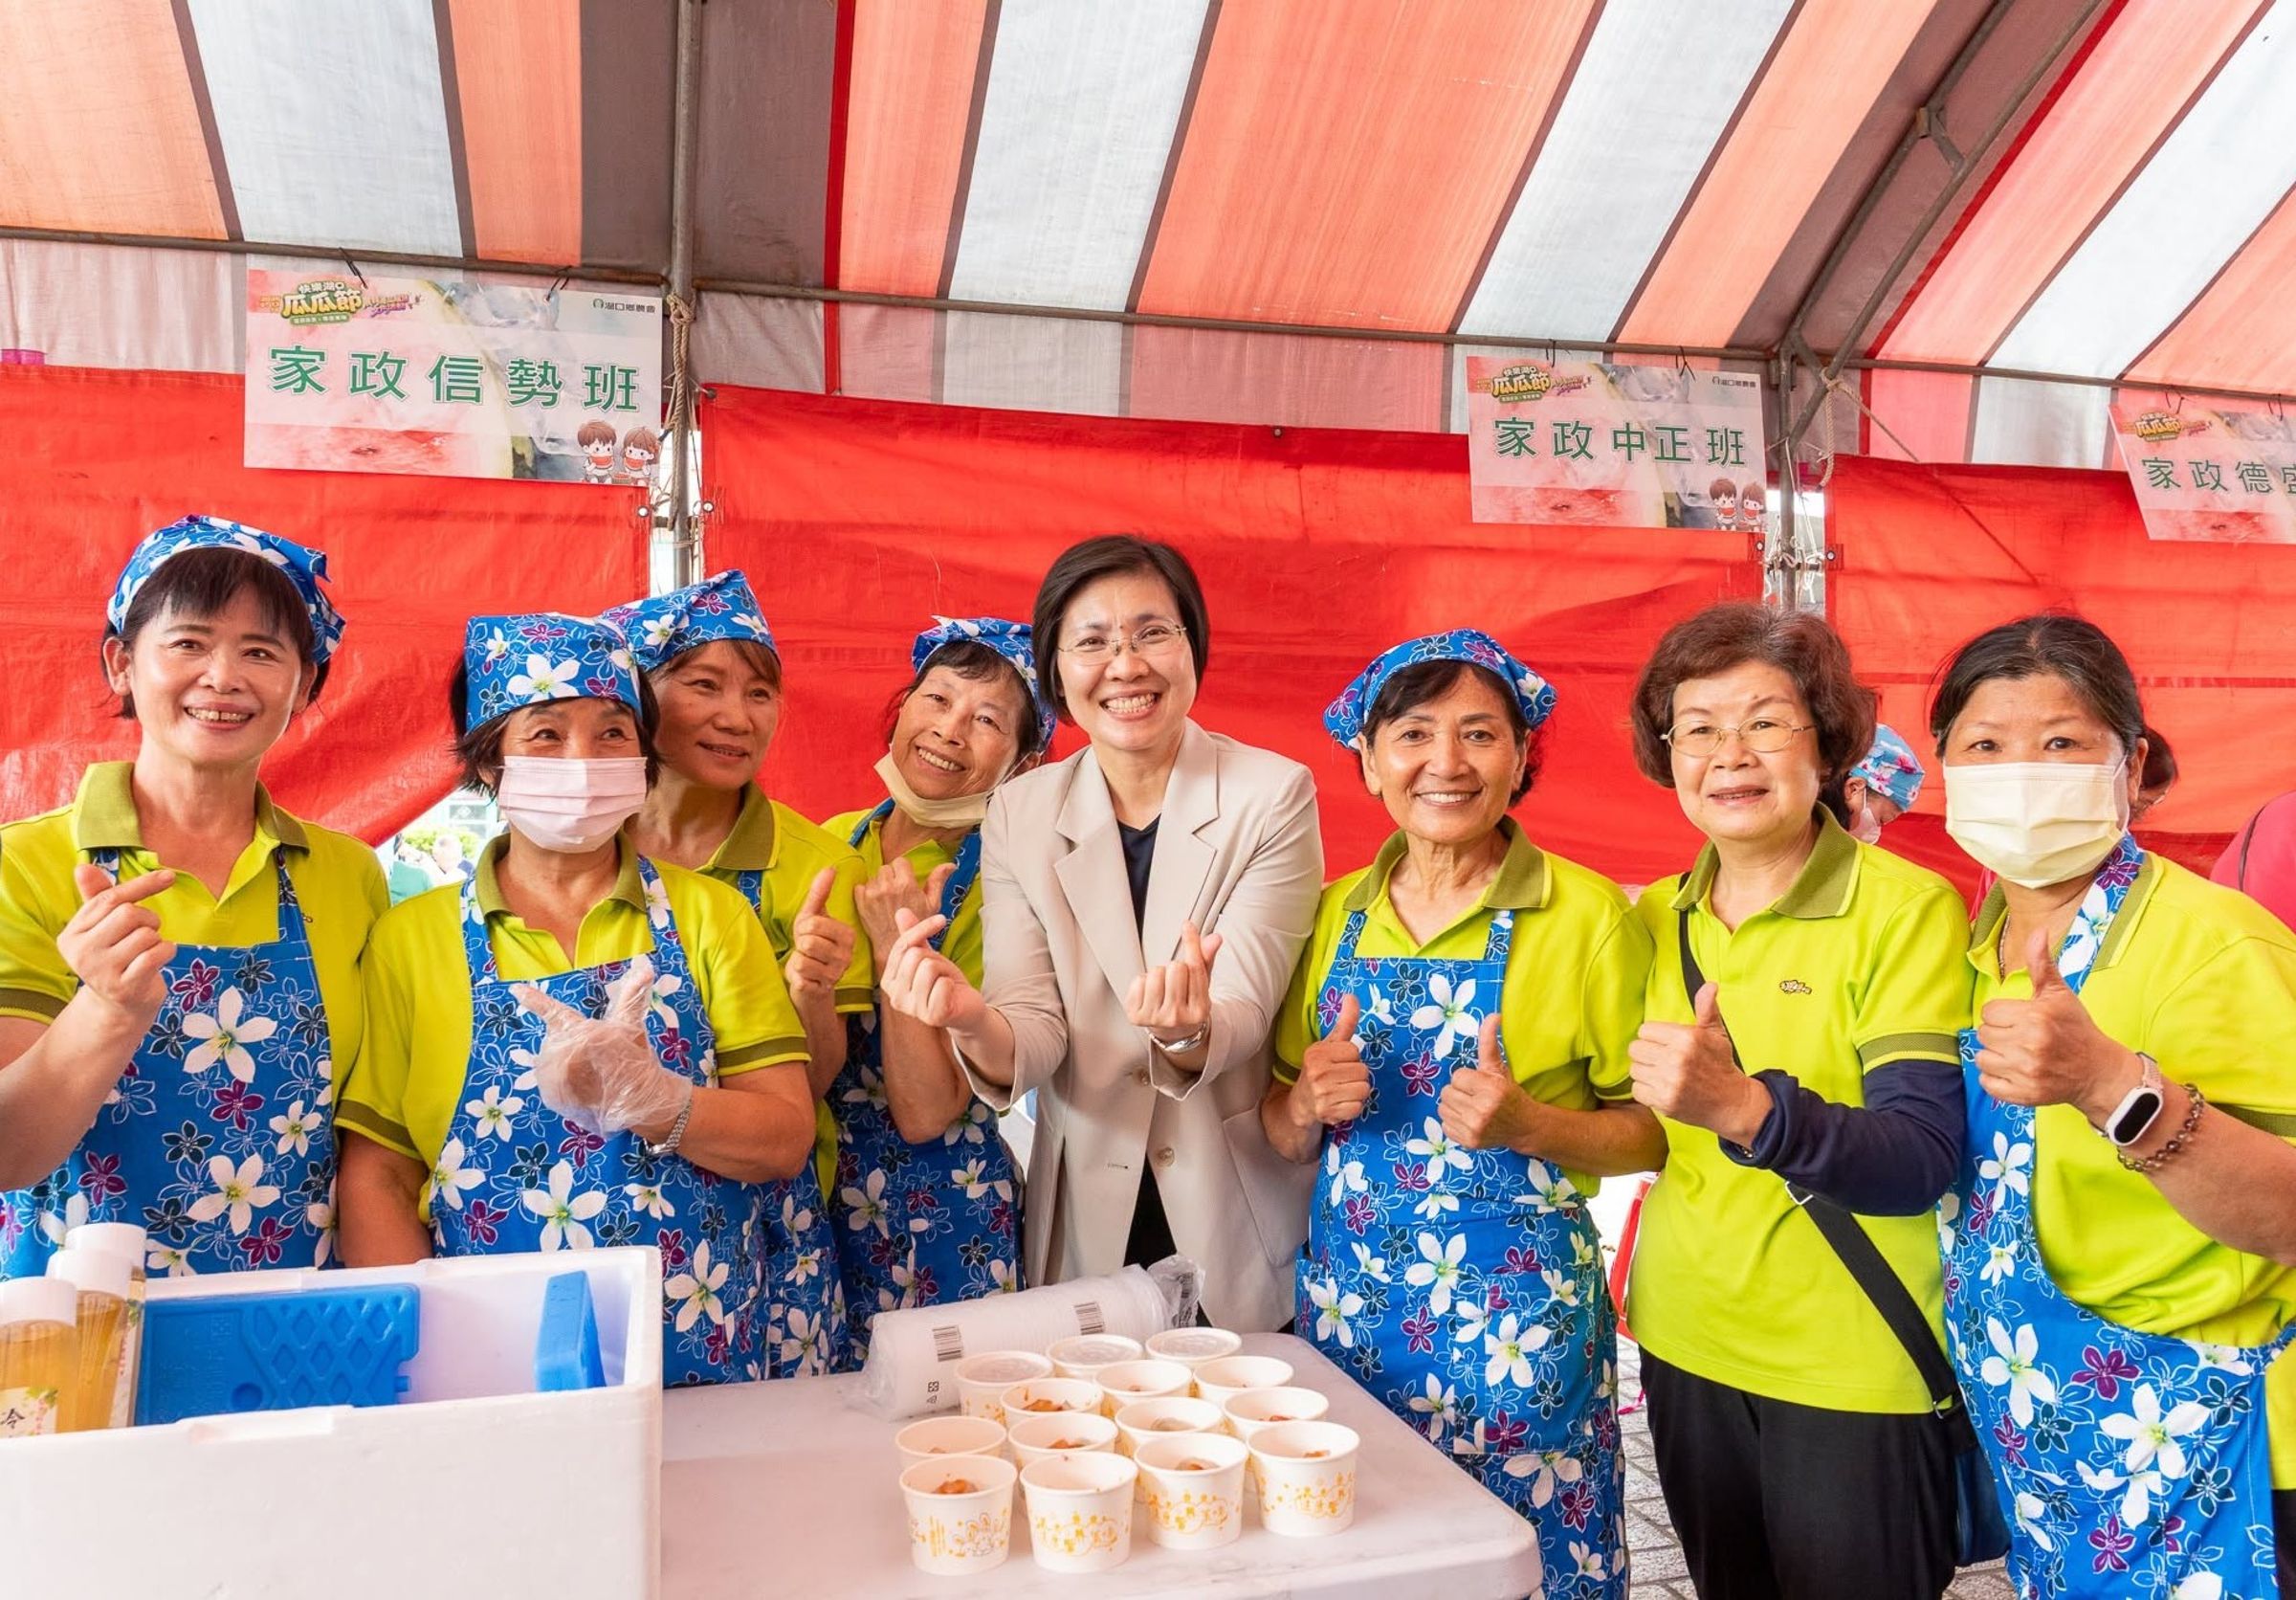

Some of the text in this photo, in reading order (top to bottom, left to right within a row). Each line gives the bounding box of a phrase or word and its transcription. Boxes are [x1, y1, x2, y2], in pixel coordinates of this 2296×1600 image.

[282, 289, 363, 317] 瓜瓜節
[269, 344, 640, 412] 家政信勢班
[1493, 416, 1746, 466] 家政中正班
